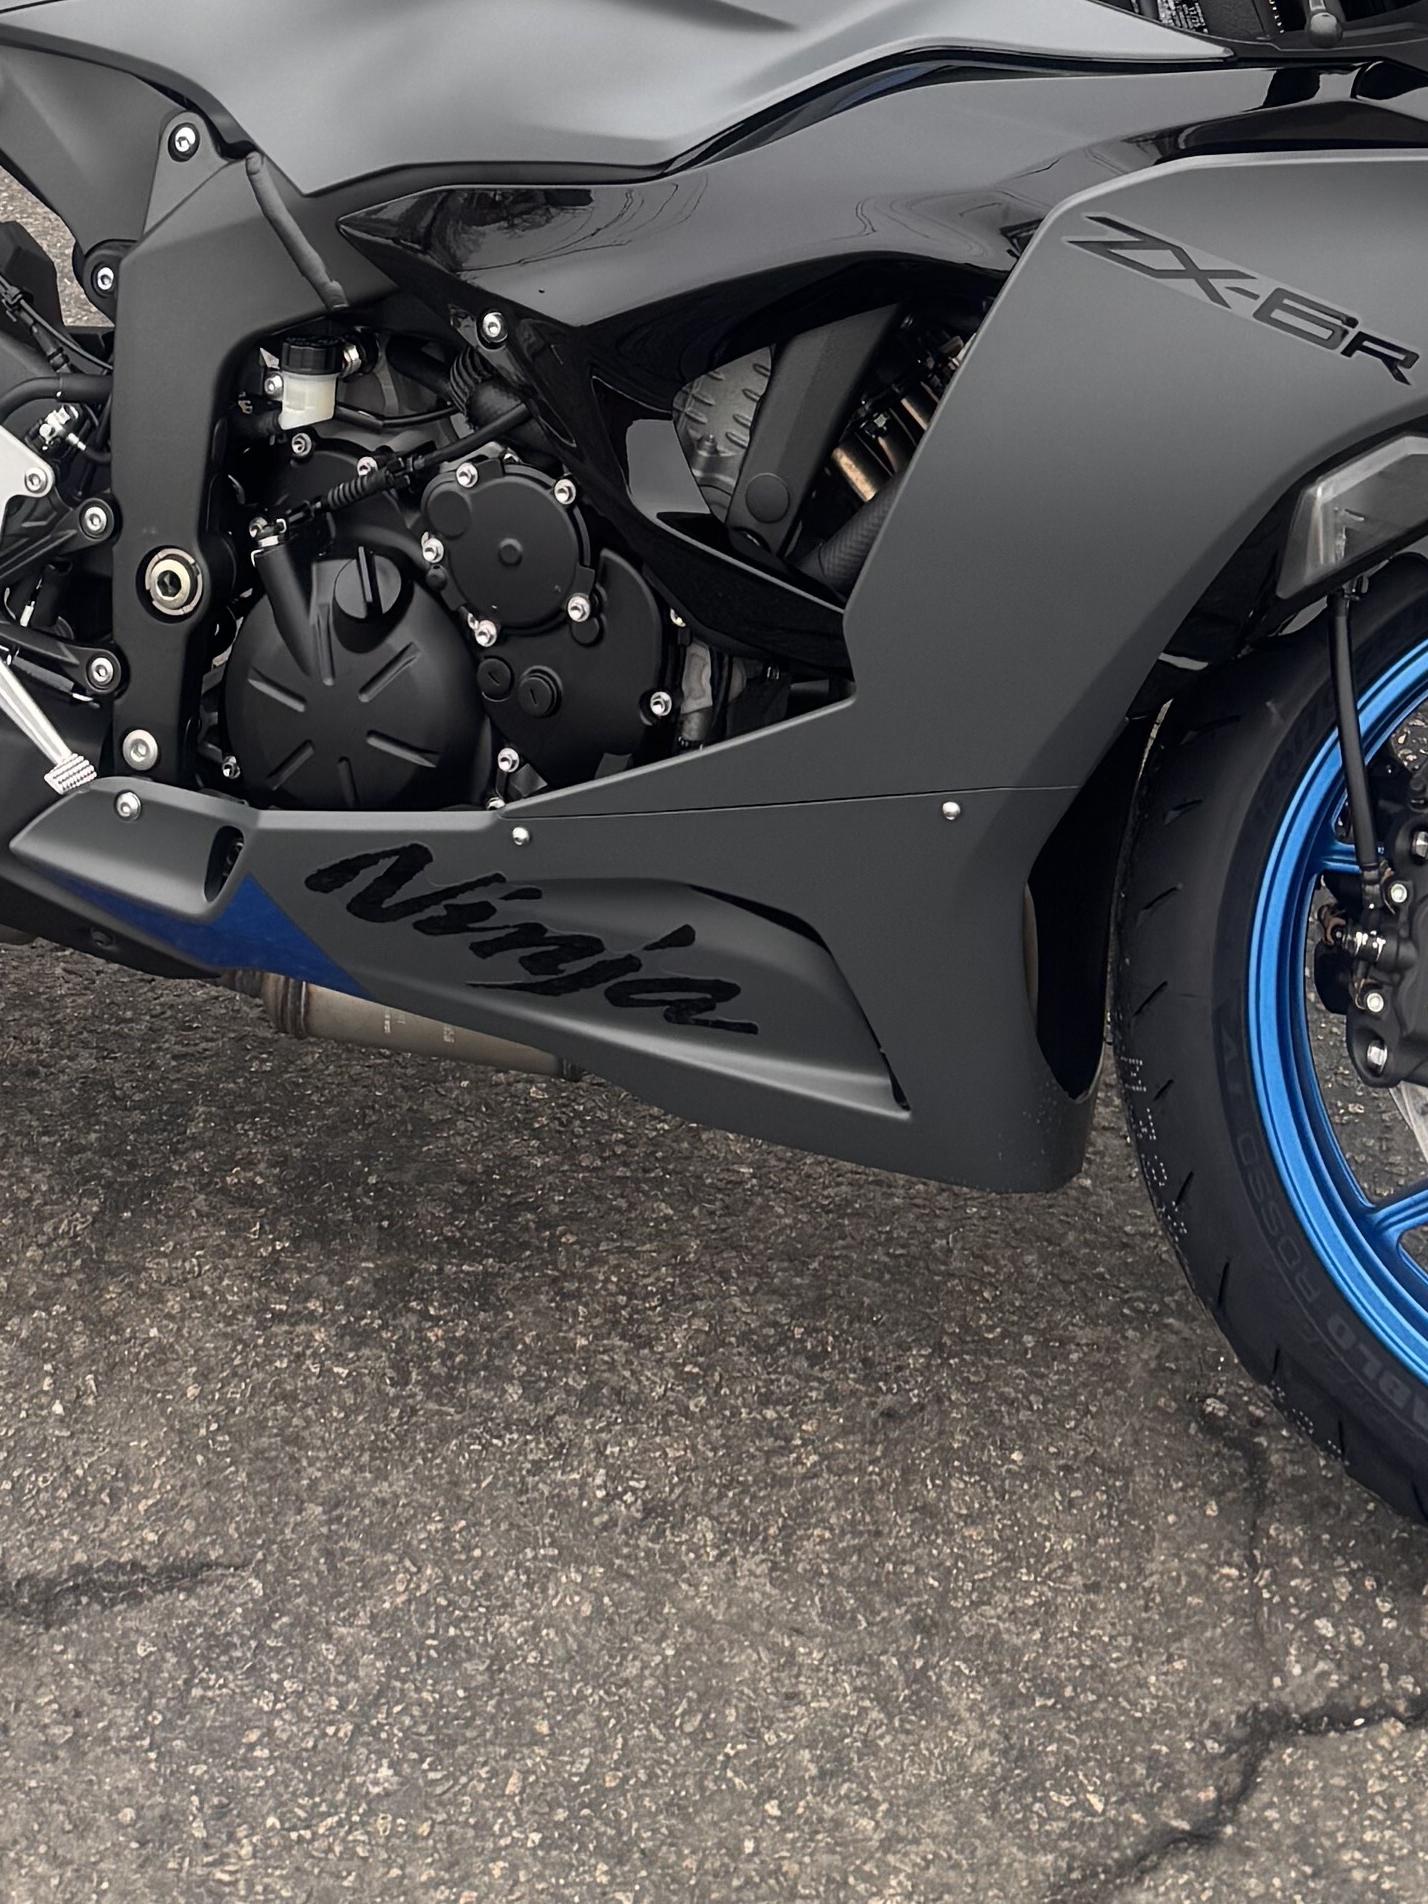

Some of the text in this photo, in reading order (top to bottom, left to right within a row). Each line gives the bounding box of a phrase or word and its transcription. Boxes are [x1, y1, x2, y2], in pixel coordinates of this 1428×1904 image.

[1065, 215, 1420, 387] ZX-6R
[304, 842, 759, 1035] Ninja
[1235, 1131, 1322, 1303] ROSSO
